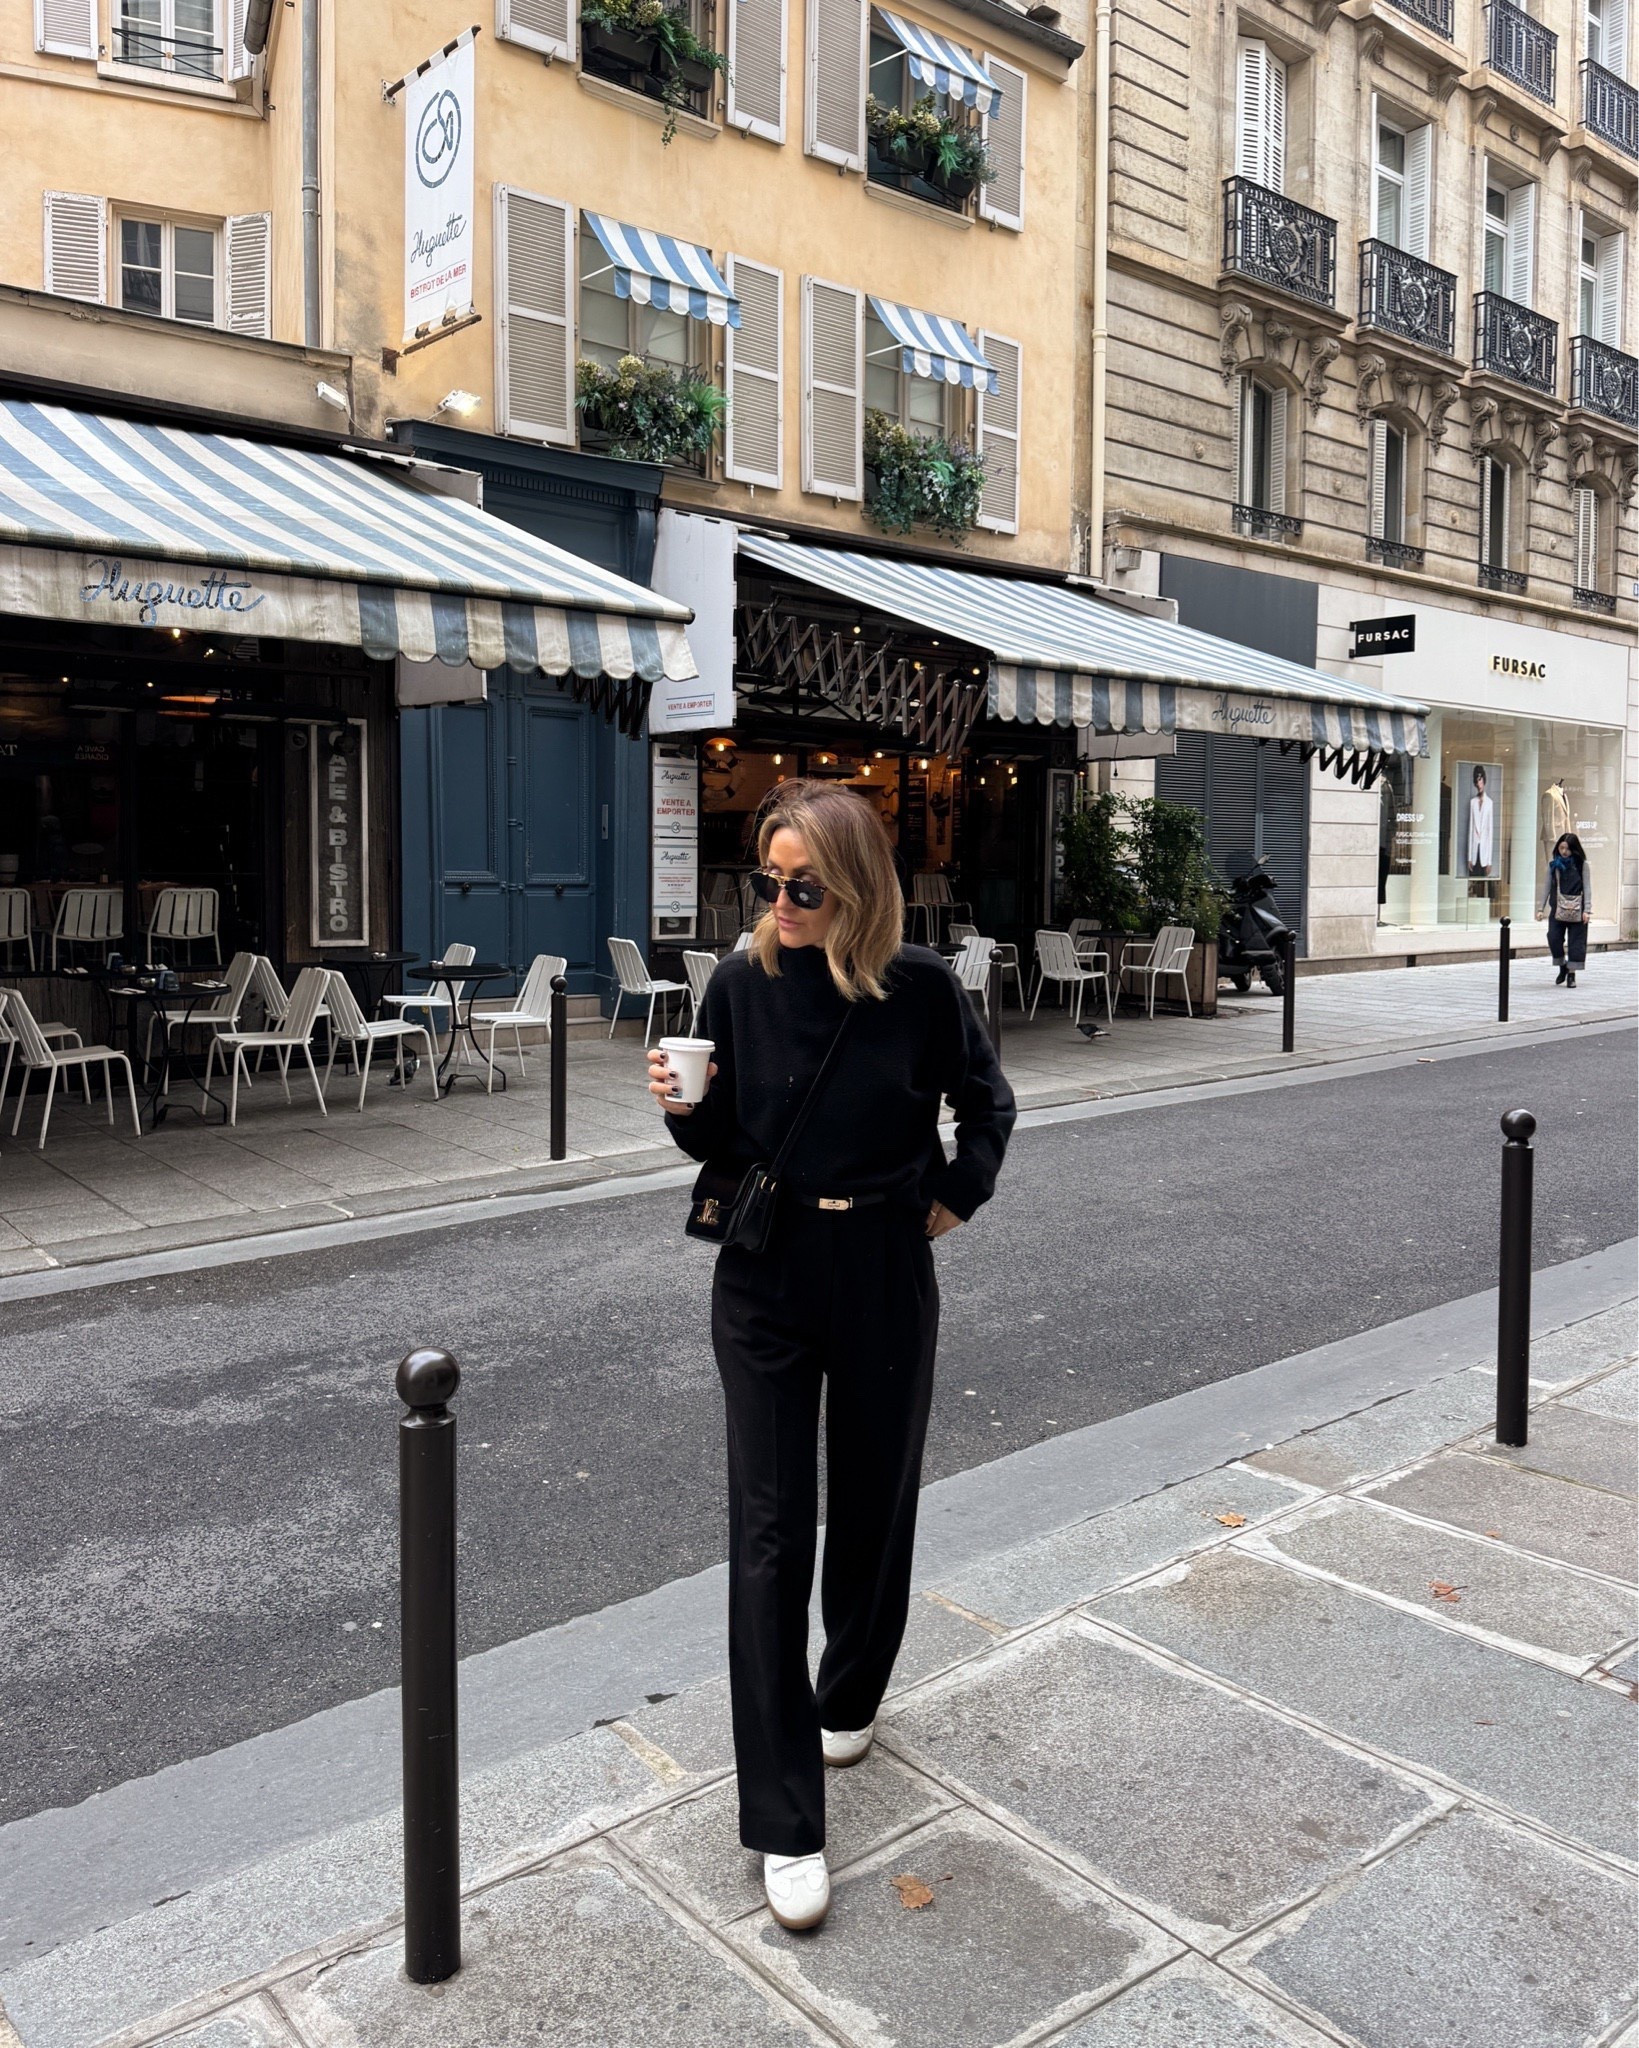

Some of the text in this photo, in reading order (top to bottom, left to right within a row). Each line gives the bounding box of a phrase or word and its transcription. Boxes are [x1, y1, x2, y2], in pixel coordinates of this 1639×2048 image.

[411, 211, 467, 267] Huguette
[410, 264, 467, 298] BISTROT DE LA MER
[79, 558, 265, 627] Huguette
[1357, 629, 1410, 644] FURSAC
[1492, 655, 1547, 678] FURSAC
[667, 703, 683, 711] VENTE
[687, 700, 713, 709] EMPORTER
[1211, 692, 1277, 734] Huguette
[661, 769, 692, 784] Huguette
[656, 807, 696, 816] EMPORTER
[661, 798, 685, 807] VENTE
[328, 805, 348, 824] &
[660, 850, 692, 865] Huguette
[328, 828, 349, 933] BISTRO
